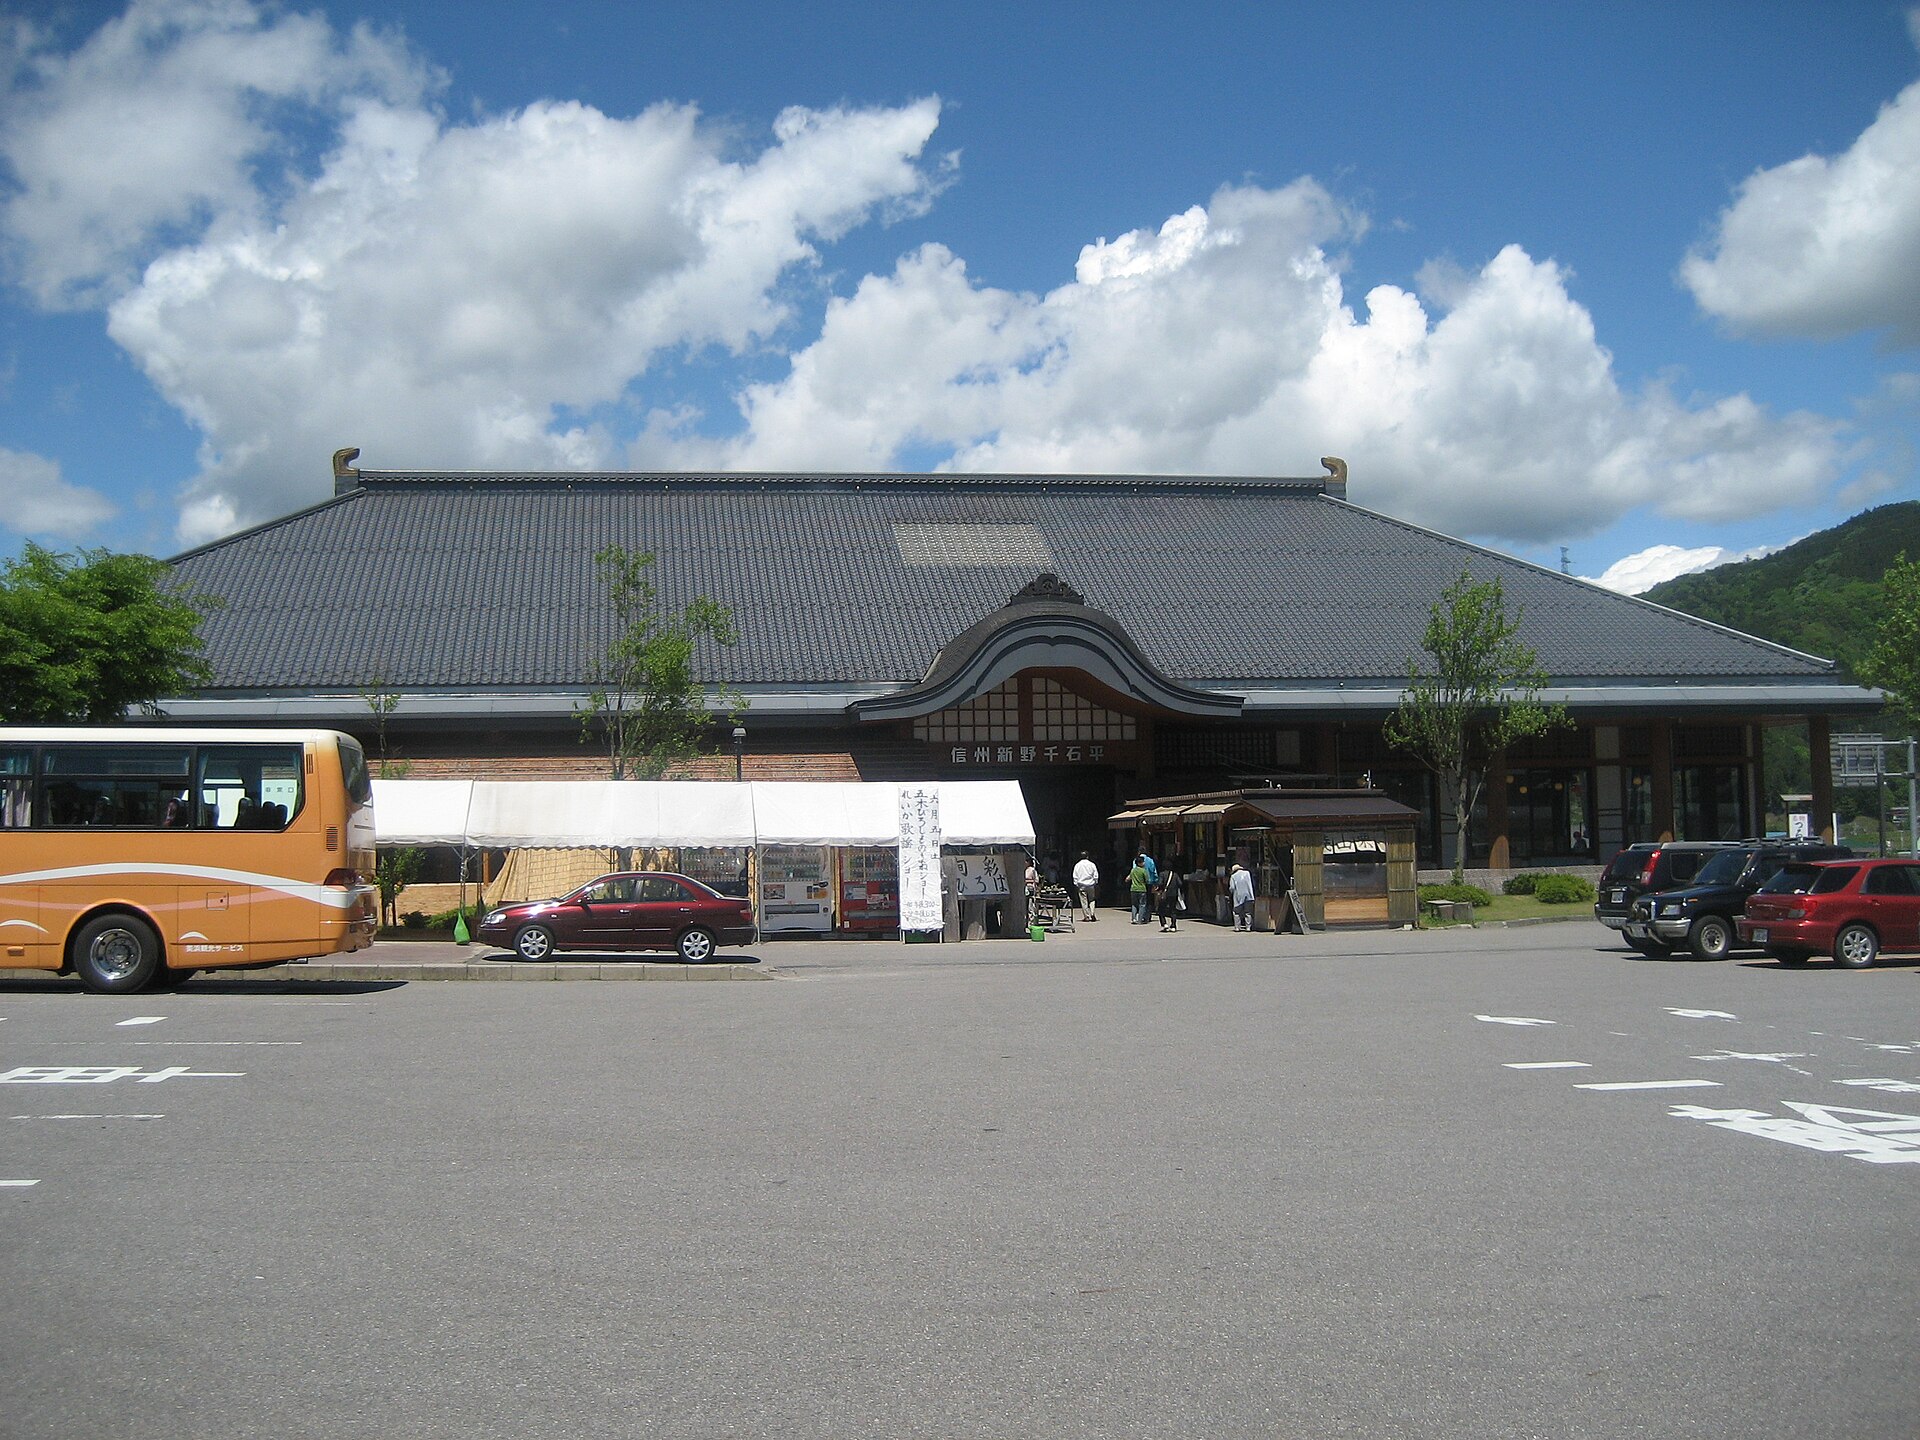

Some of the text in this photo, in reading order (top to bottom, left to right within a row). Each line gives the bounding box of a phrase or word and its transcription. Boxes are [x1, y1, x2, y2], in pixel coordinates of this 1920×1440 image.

[951, 746, 1104, 763] 信州新野千石平
